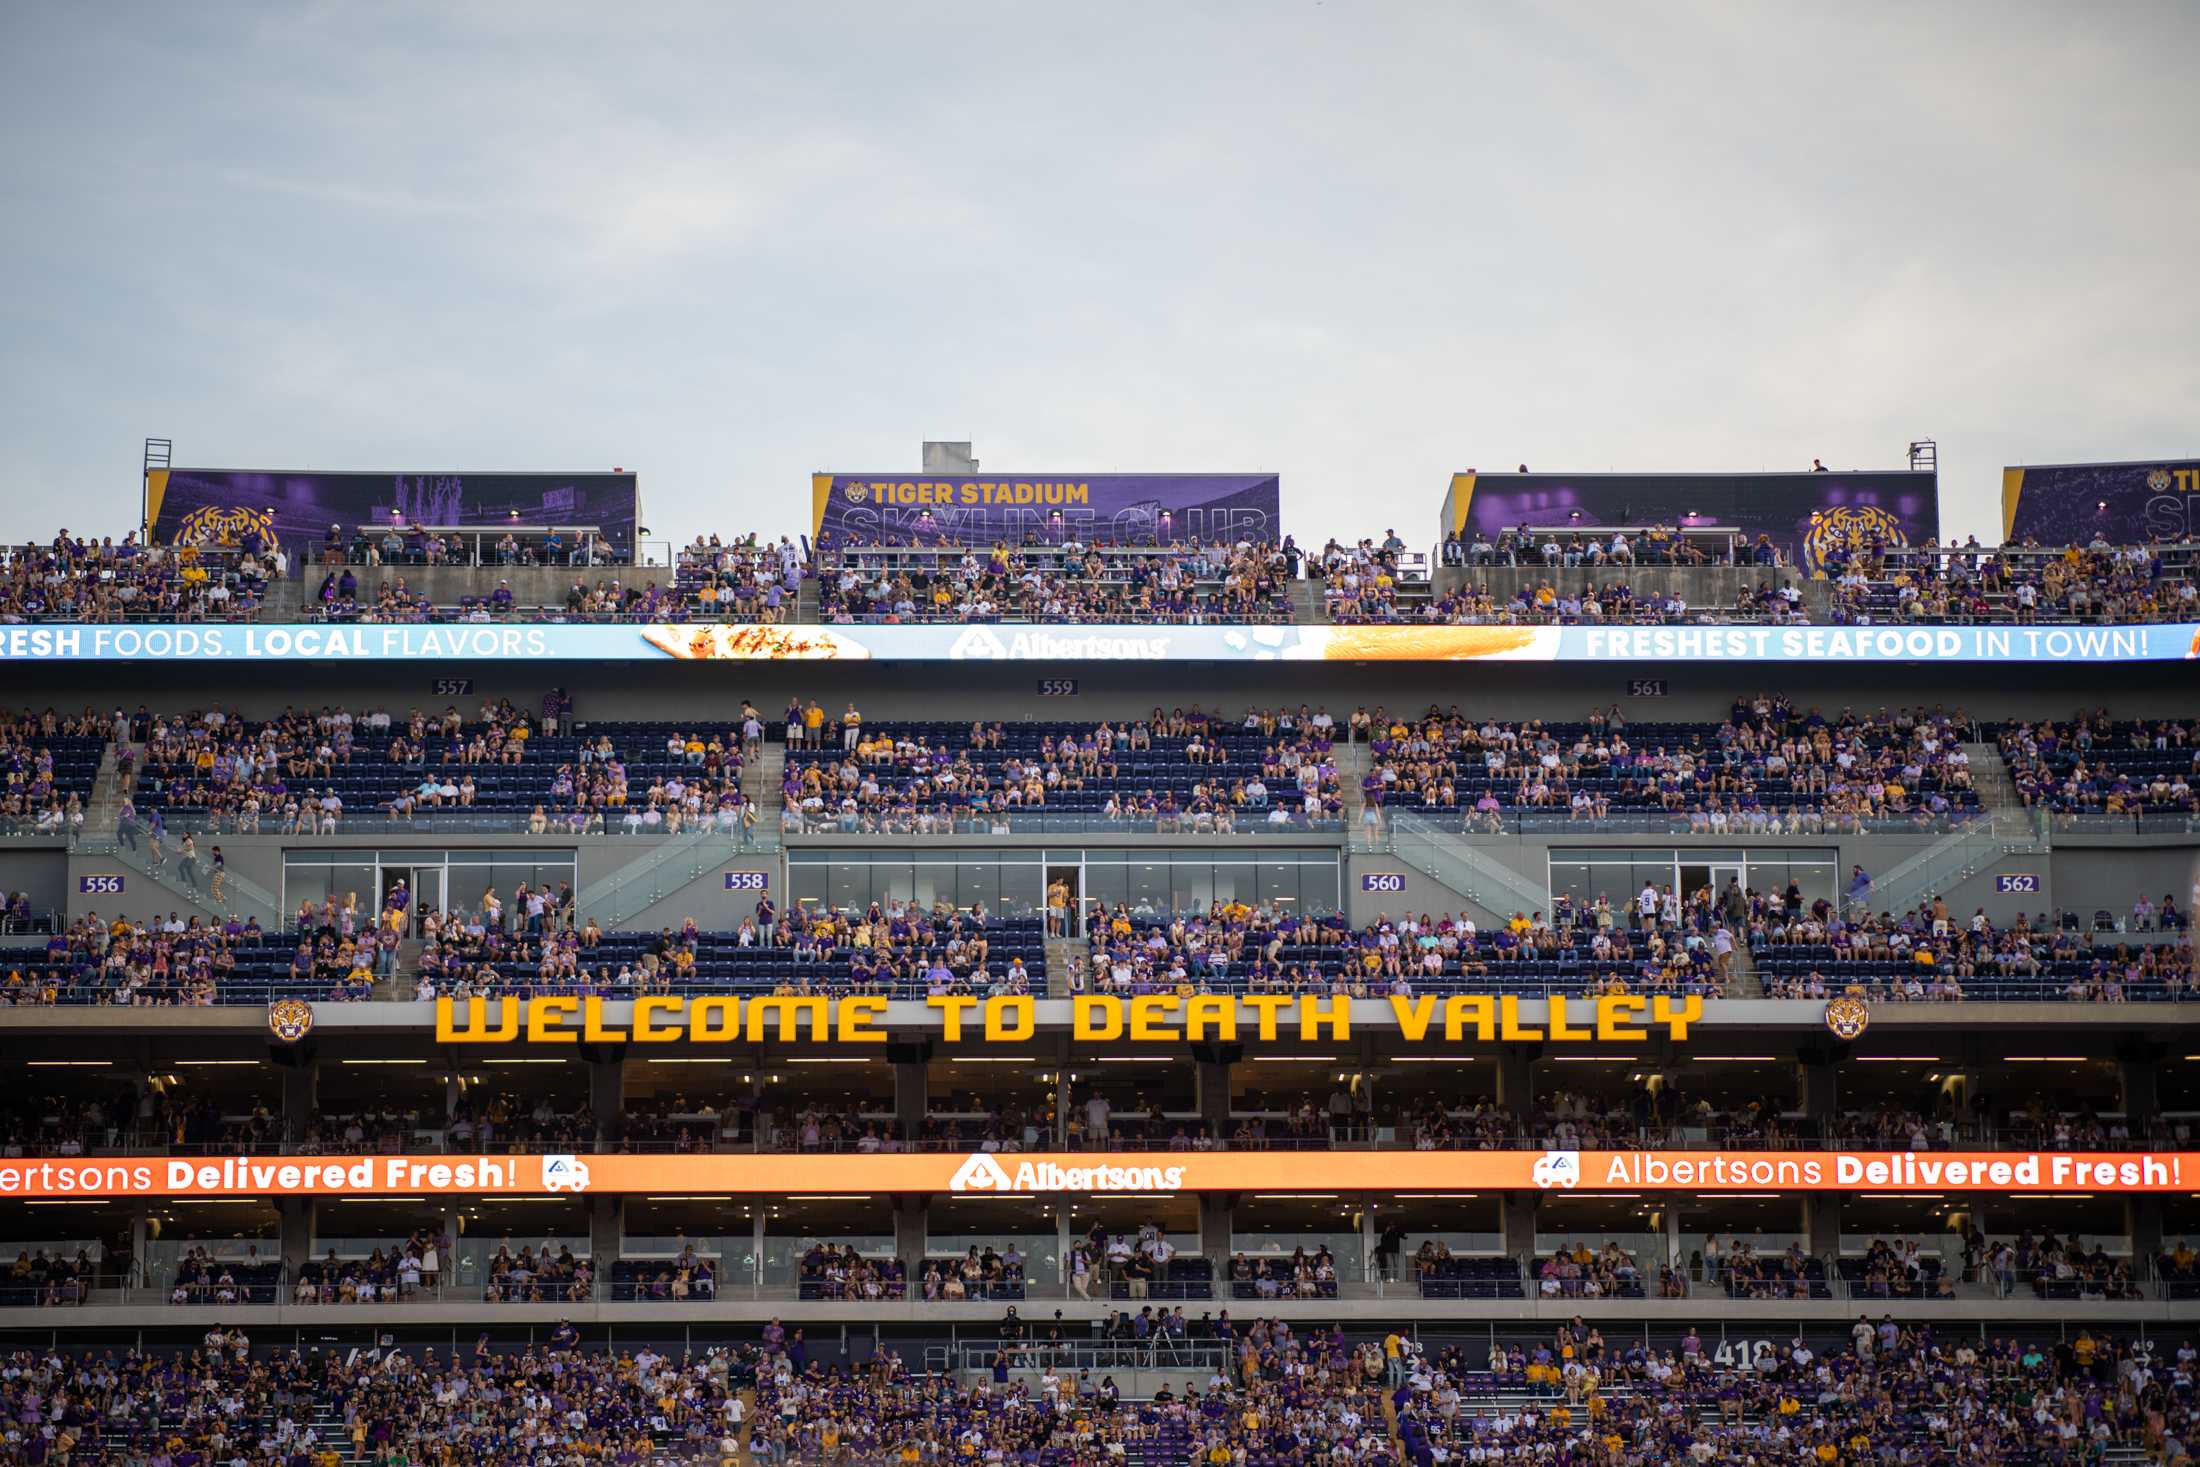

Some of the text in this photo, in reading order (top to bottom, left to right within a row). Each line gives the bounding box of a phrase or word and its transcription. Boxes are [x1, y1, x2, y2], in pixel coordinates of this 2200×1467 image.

[870, 482, 1089, 505] TIGER STADIUM
[841, 507, 1269, 548] SKYLINE CLUB
[0, 629, 556, 657] ESH FOODS. LOCAL FLAVORS.
[1009, 632, 1170, 659] Albertsons
[1586, 629, 2148, 656] FRESHEST SEAFOOD IN TOWN!
[437, 680, 468, 695] 557
[1042, 680, 1073, 695] 559
[1632, 681, 1662, 696] 561
[86, 877, 119, 892] 556
[731, 873, 763, 889] 558
[1368, 875, 1400, 891] 560
[2002, 876, 2034, 891] 562
[436, 994, 1704, 1045] WELCOME TO DEATH VALLEY
[169, 1157, 372, 1188] Delivered
[388, 1159, 514, 1186] Fresh!
[1013, 1162, 1184, 1190] Albertsons
[1607, 1153, 2178, 1184] Albertsons Delivered Fresh!
[1713, 1340, 1773, 1370] 418
